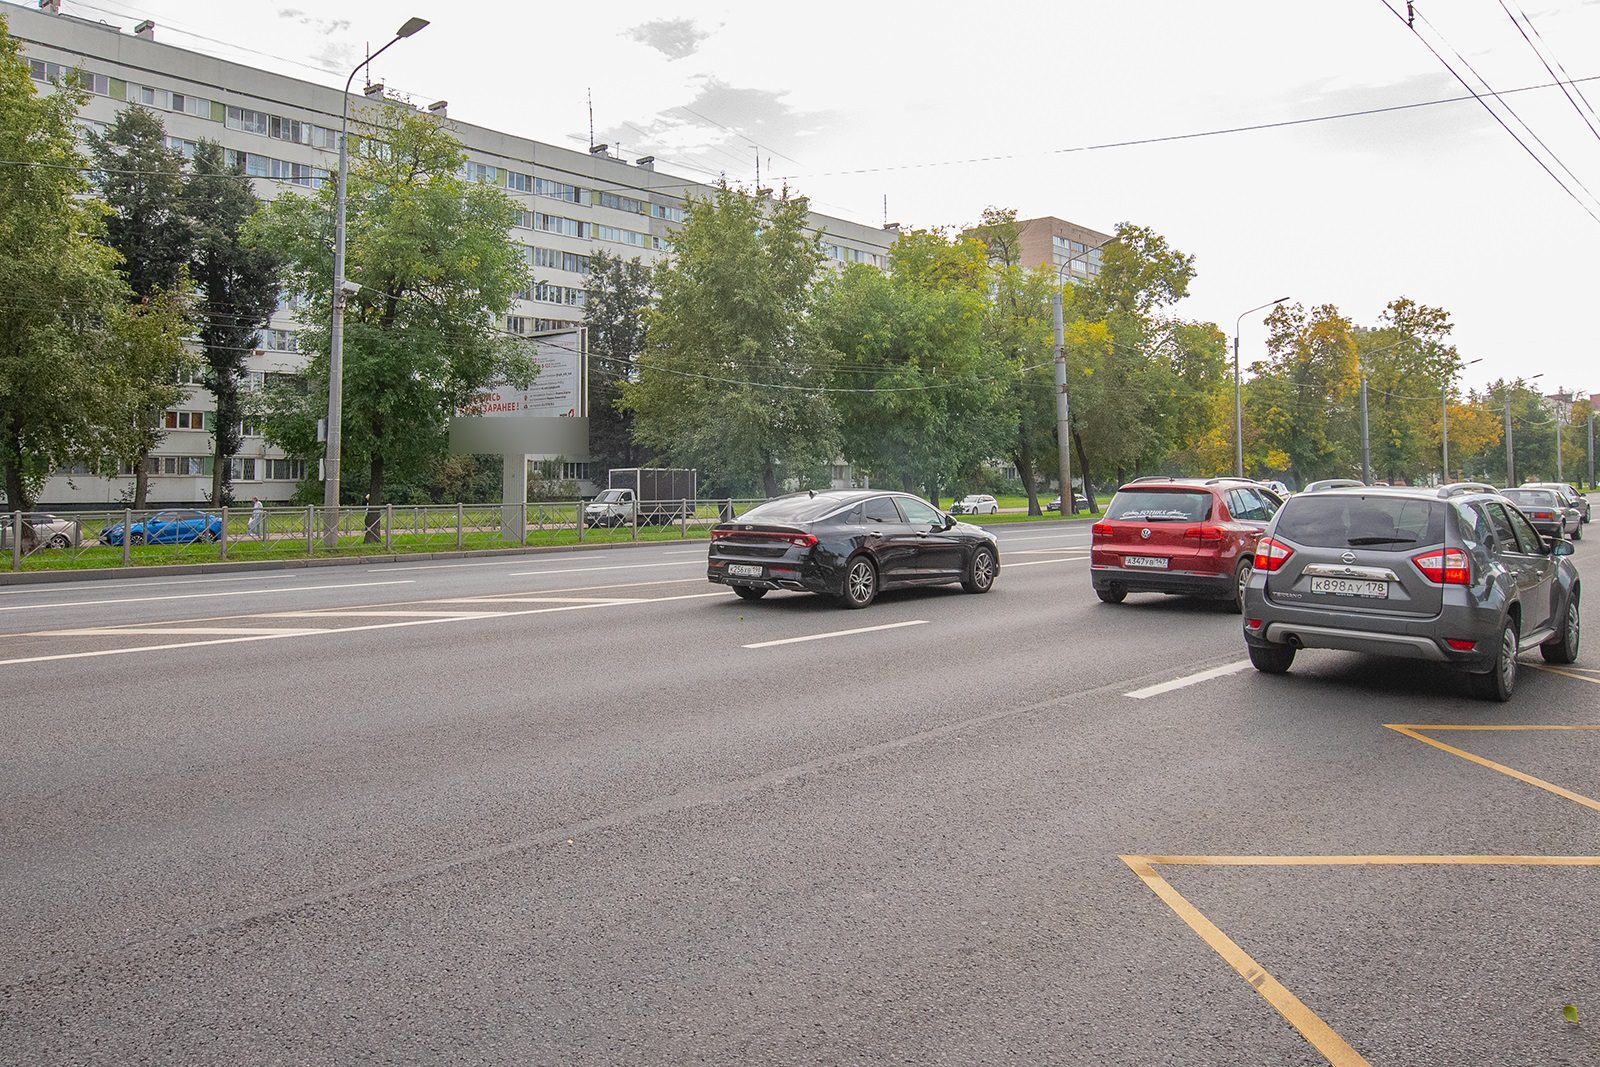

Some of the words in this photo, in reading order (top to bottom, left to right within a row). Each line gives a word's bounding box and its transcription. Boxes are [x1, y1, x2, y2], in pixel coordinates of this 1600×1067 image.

[483, 402, 520, 413] ЗАРАНЕЕ!
[1315, 579, 1362, 593] К898АУ
[1365, 582, 1384, 592] 178
